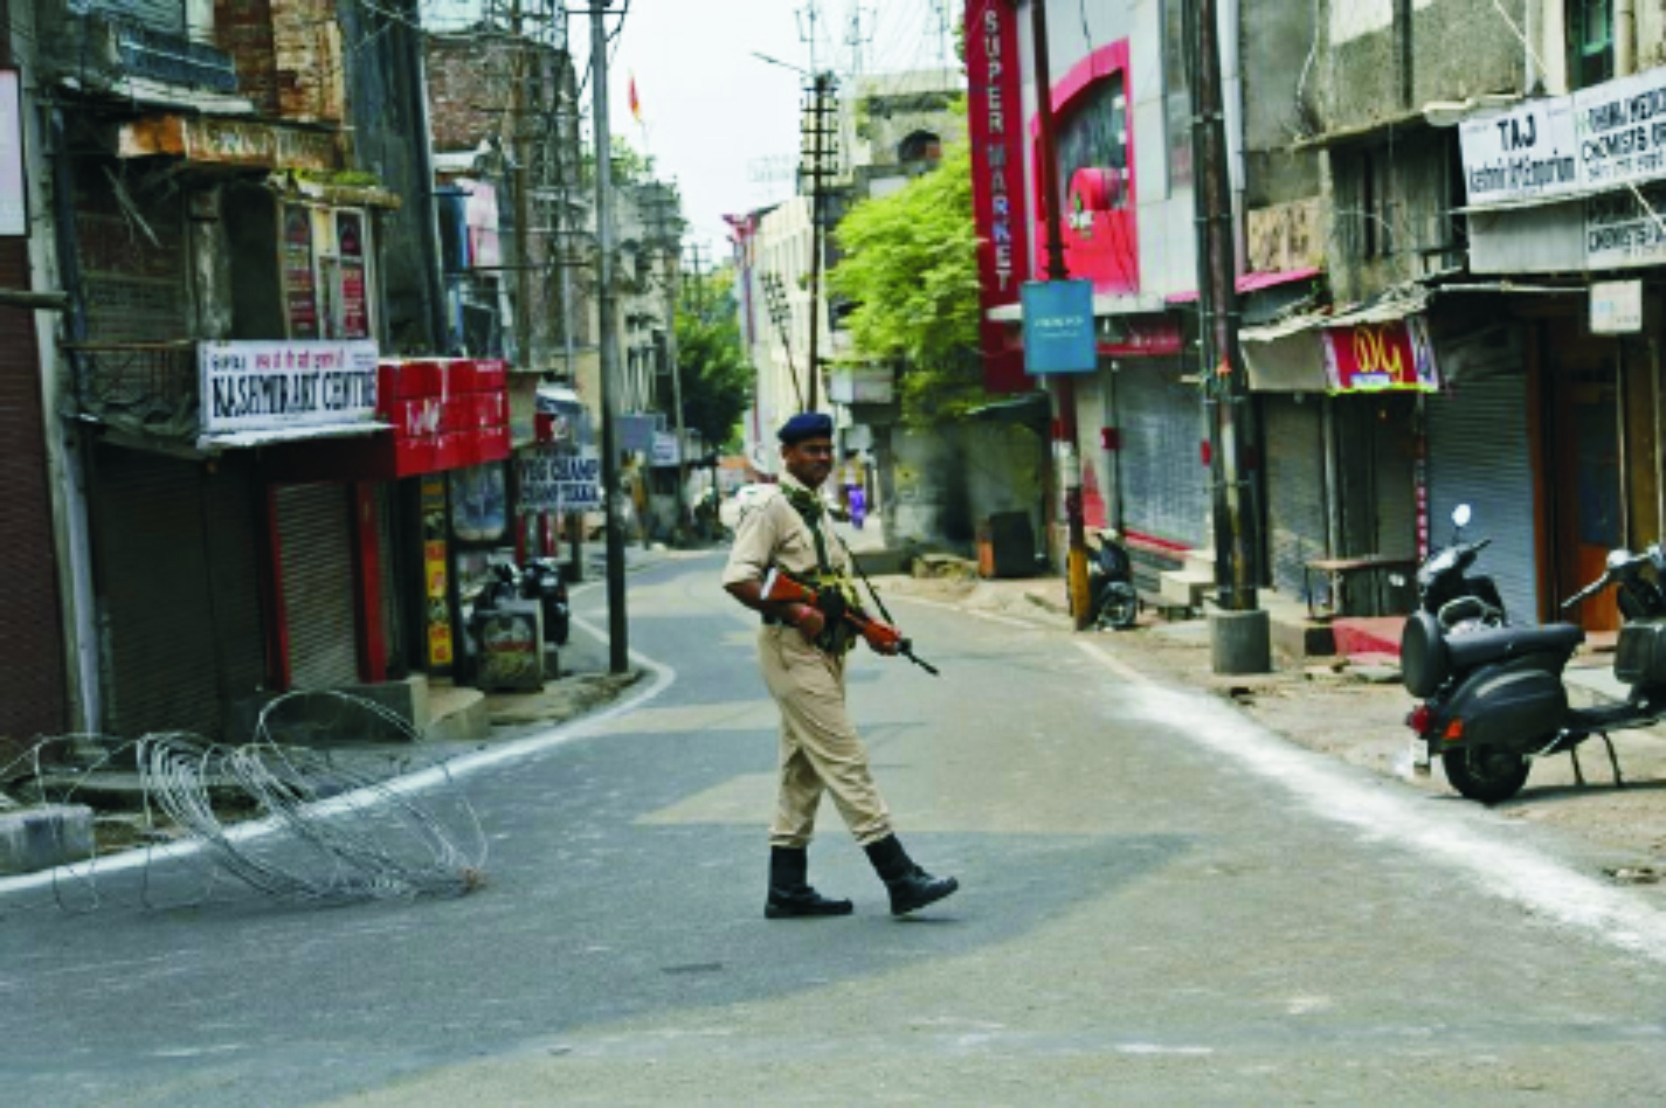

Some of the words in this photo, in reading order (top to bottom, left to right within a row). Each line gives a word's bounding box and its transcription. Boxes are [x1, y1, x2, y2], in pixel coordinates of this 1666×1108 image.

[984, 9, 1003, 134] SUPER
[1497, 112, 1536, 151] TAJ
[987, 143, 1012, 291] MARKET
